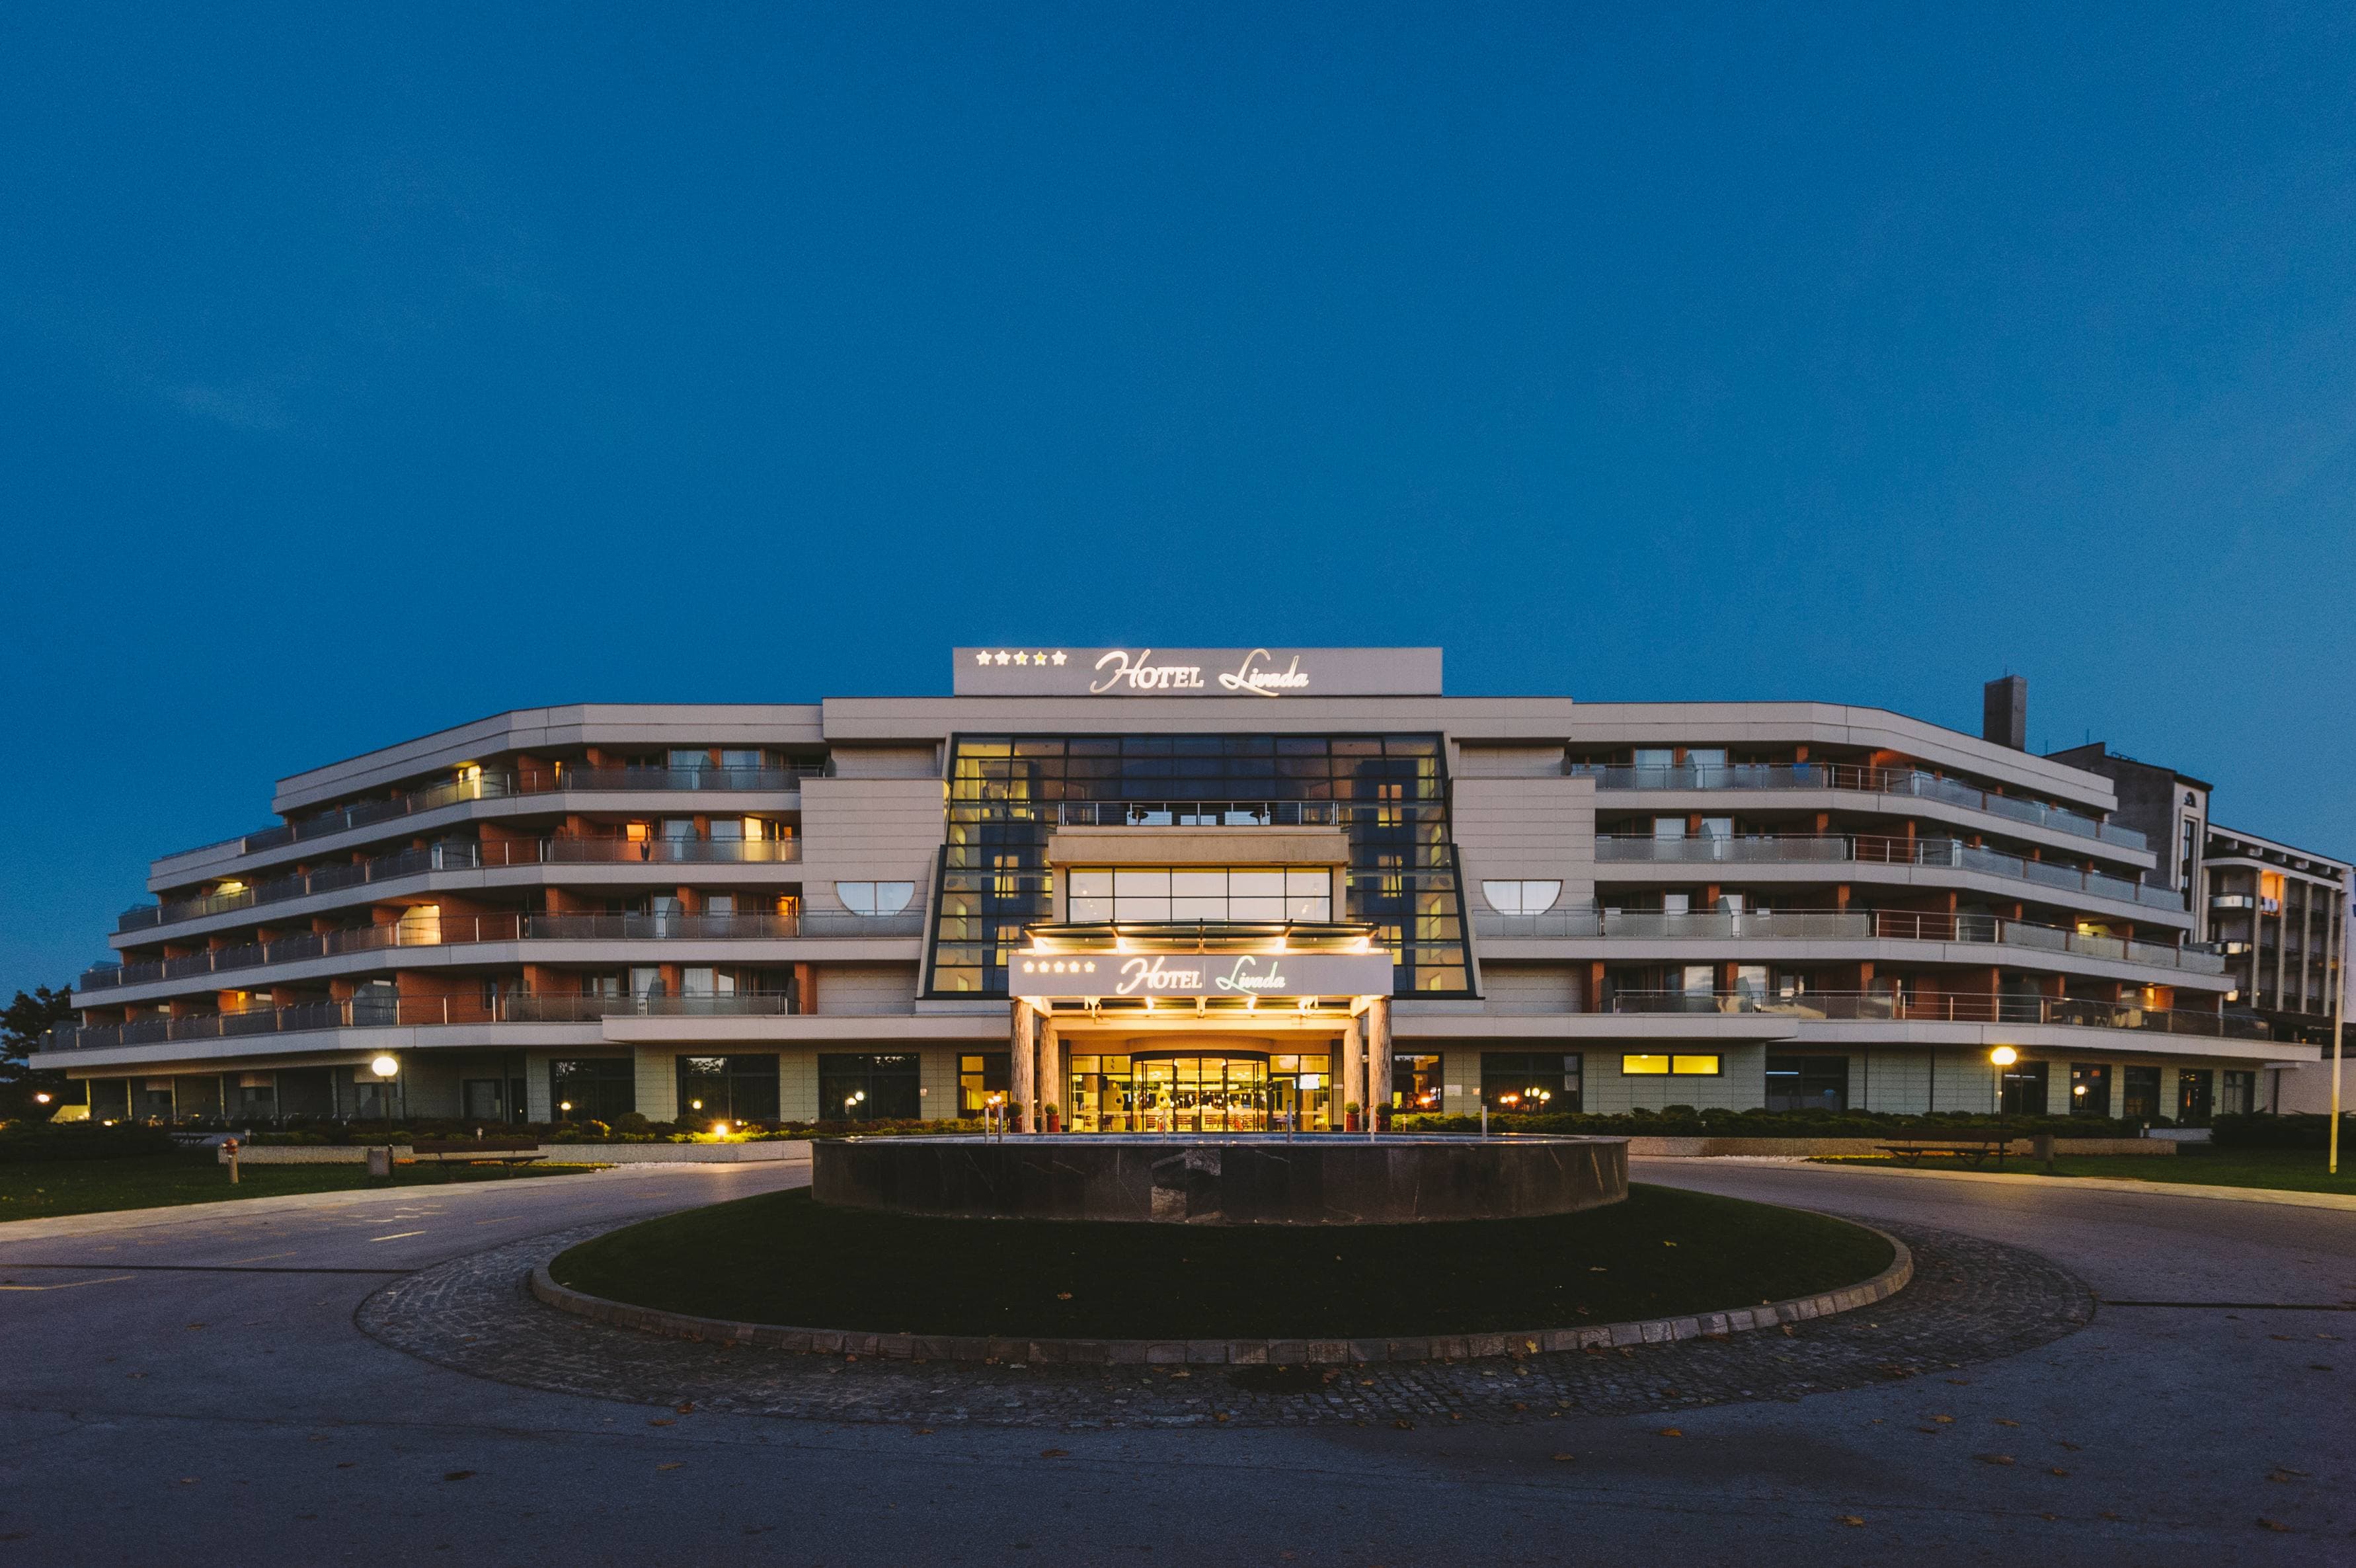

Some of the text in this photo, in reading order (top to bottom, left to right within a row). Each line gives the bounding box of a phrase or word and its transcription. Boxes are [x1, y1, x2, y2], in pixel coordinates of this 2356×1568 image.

[1090, 648, 1309, 696] HOTEL Livada
[1116, 955, 1285, 995] HOTEL Livada
